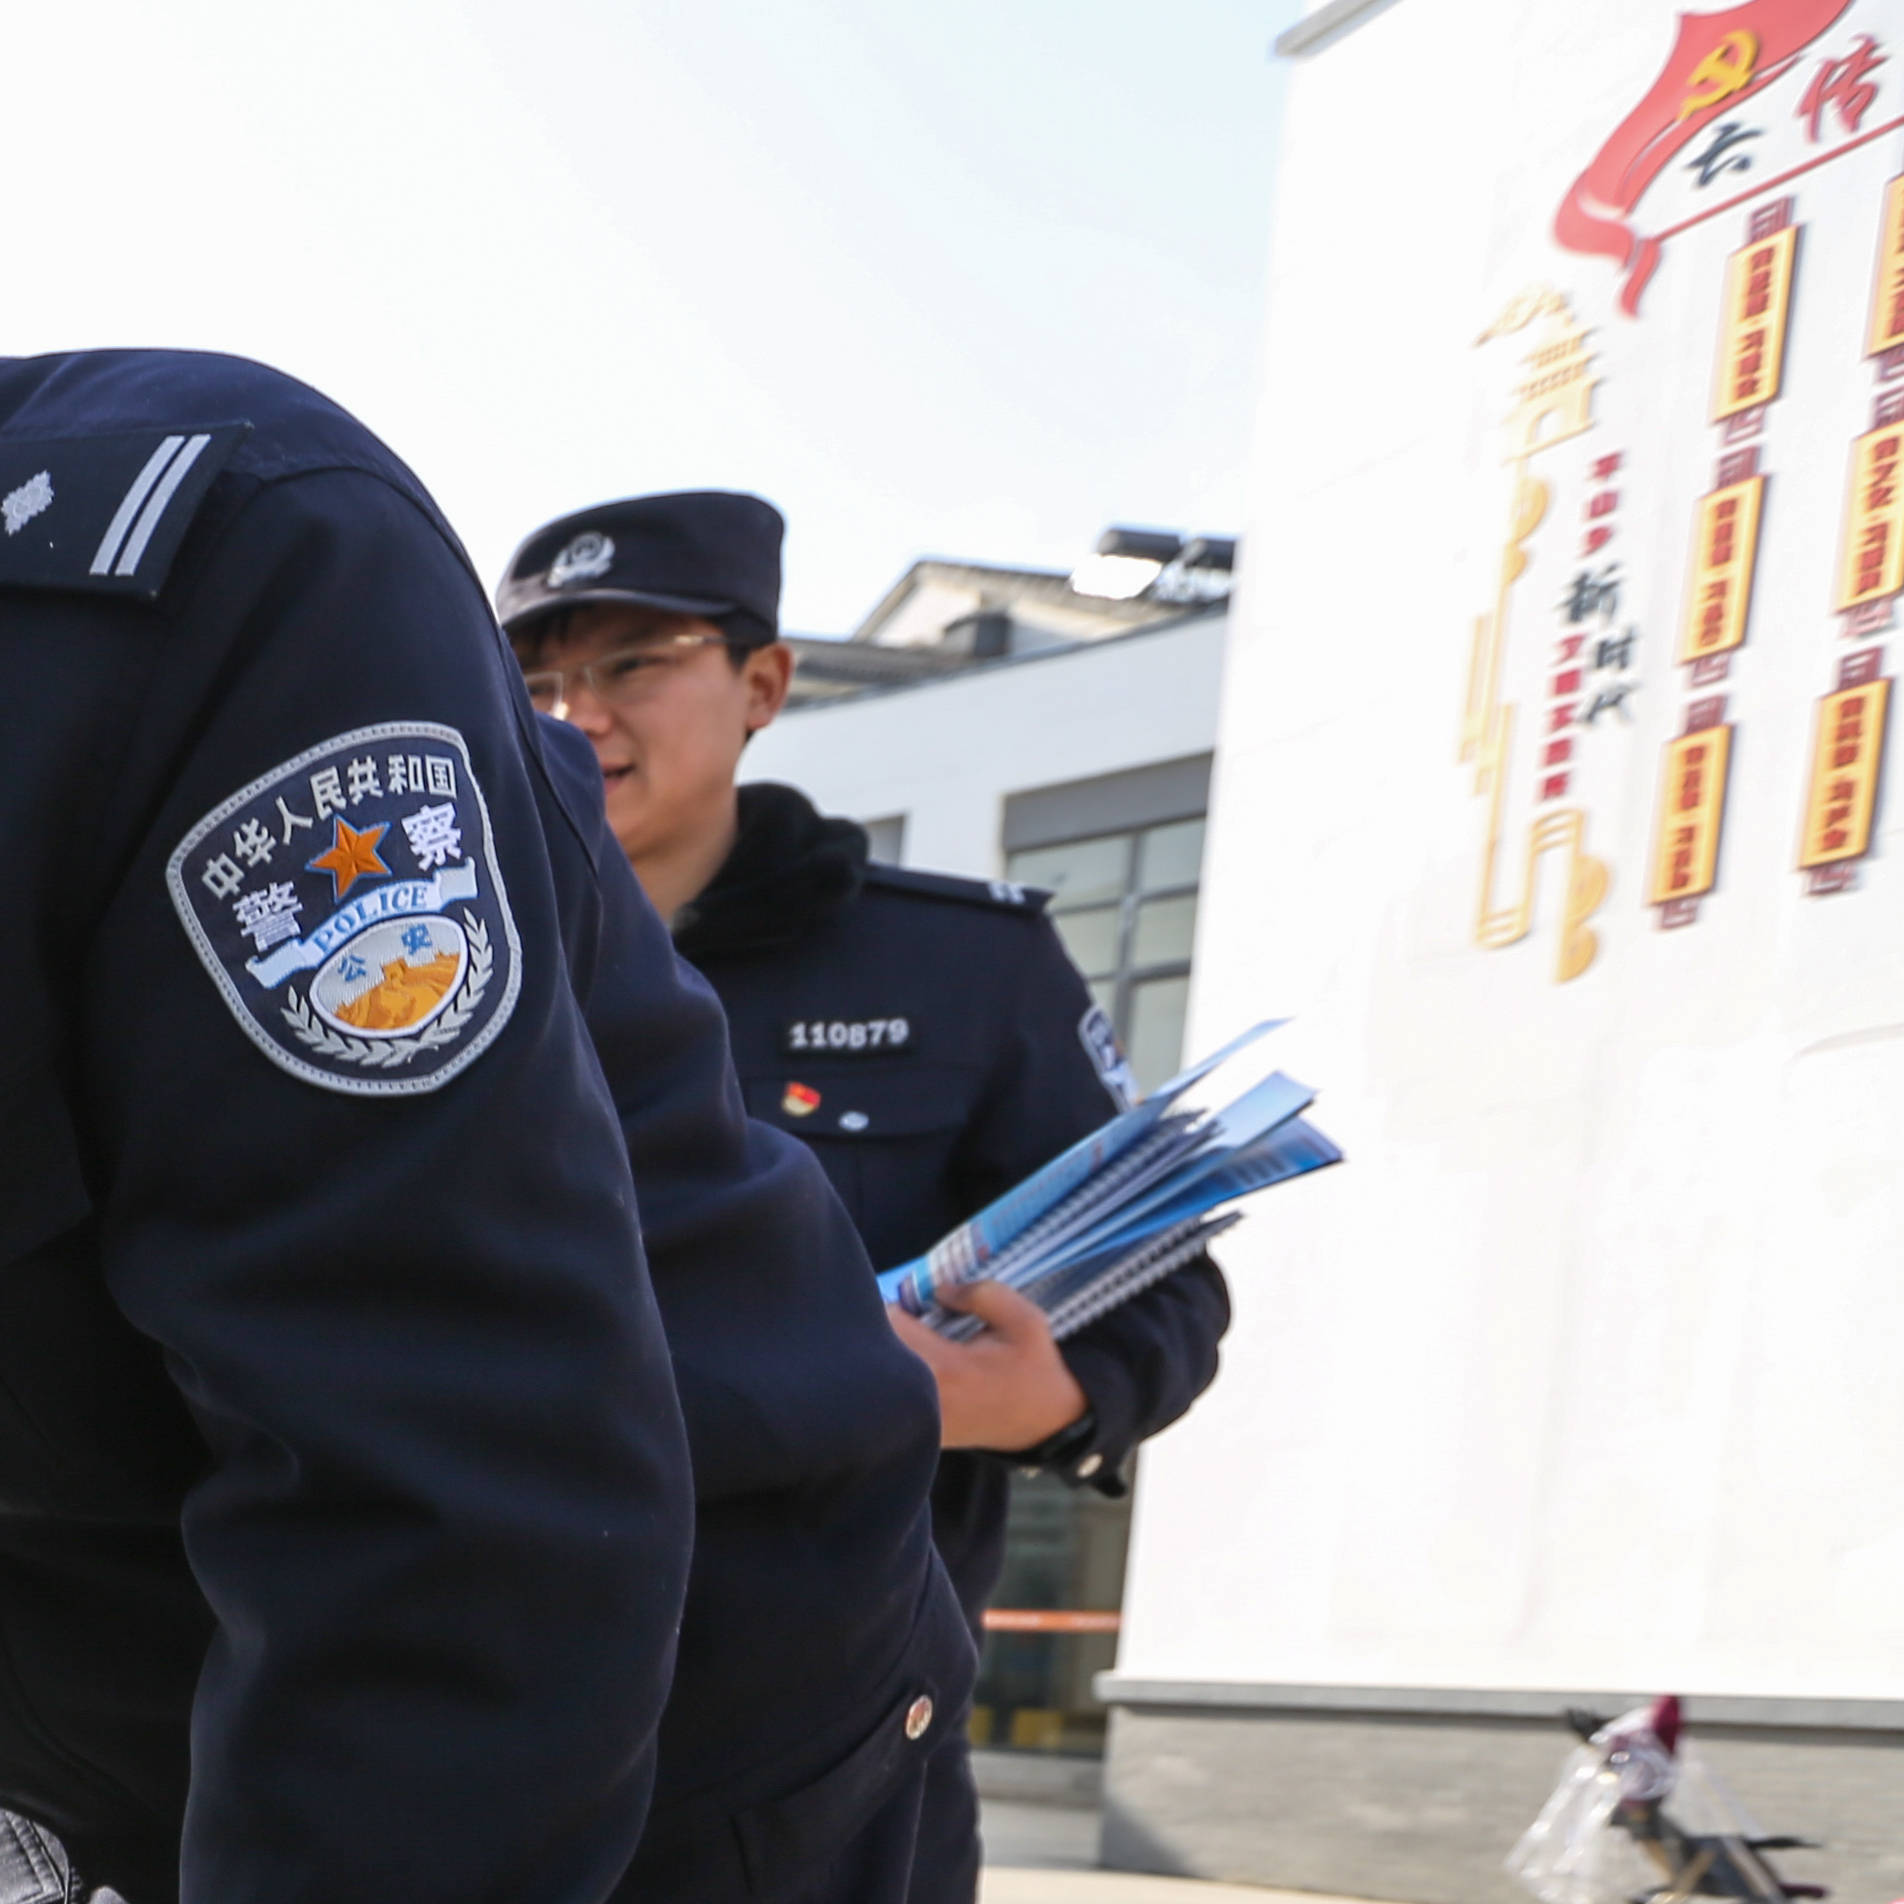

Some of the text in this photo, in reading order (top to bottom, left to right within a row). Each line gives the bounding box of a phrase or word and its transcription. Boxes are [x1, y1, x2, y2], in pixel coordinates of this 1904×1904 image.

[200, 754, 458, 900] 中华人民共和国
[232, 802, 463, 952] 警 察
[312, 884, 429, 953] POLICE
[338, 922, 433, 983] 公 安
[789, 1017, 910, 1049] 110879
